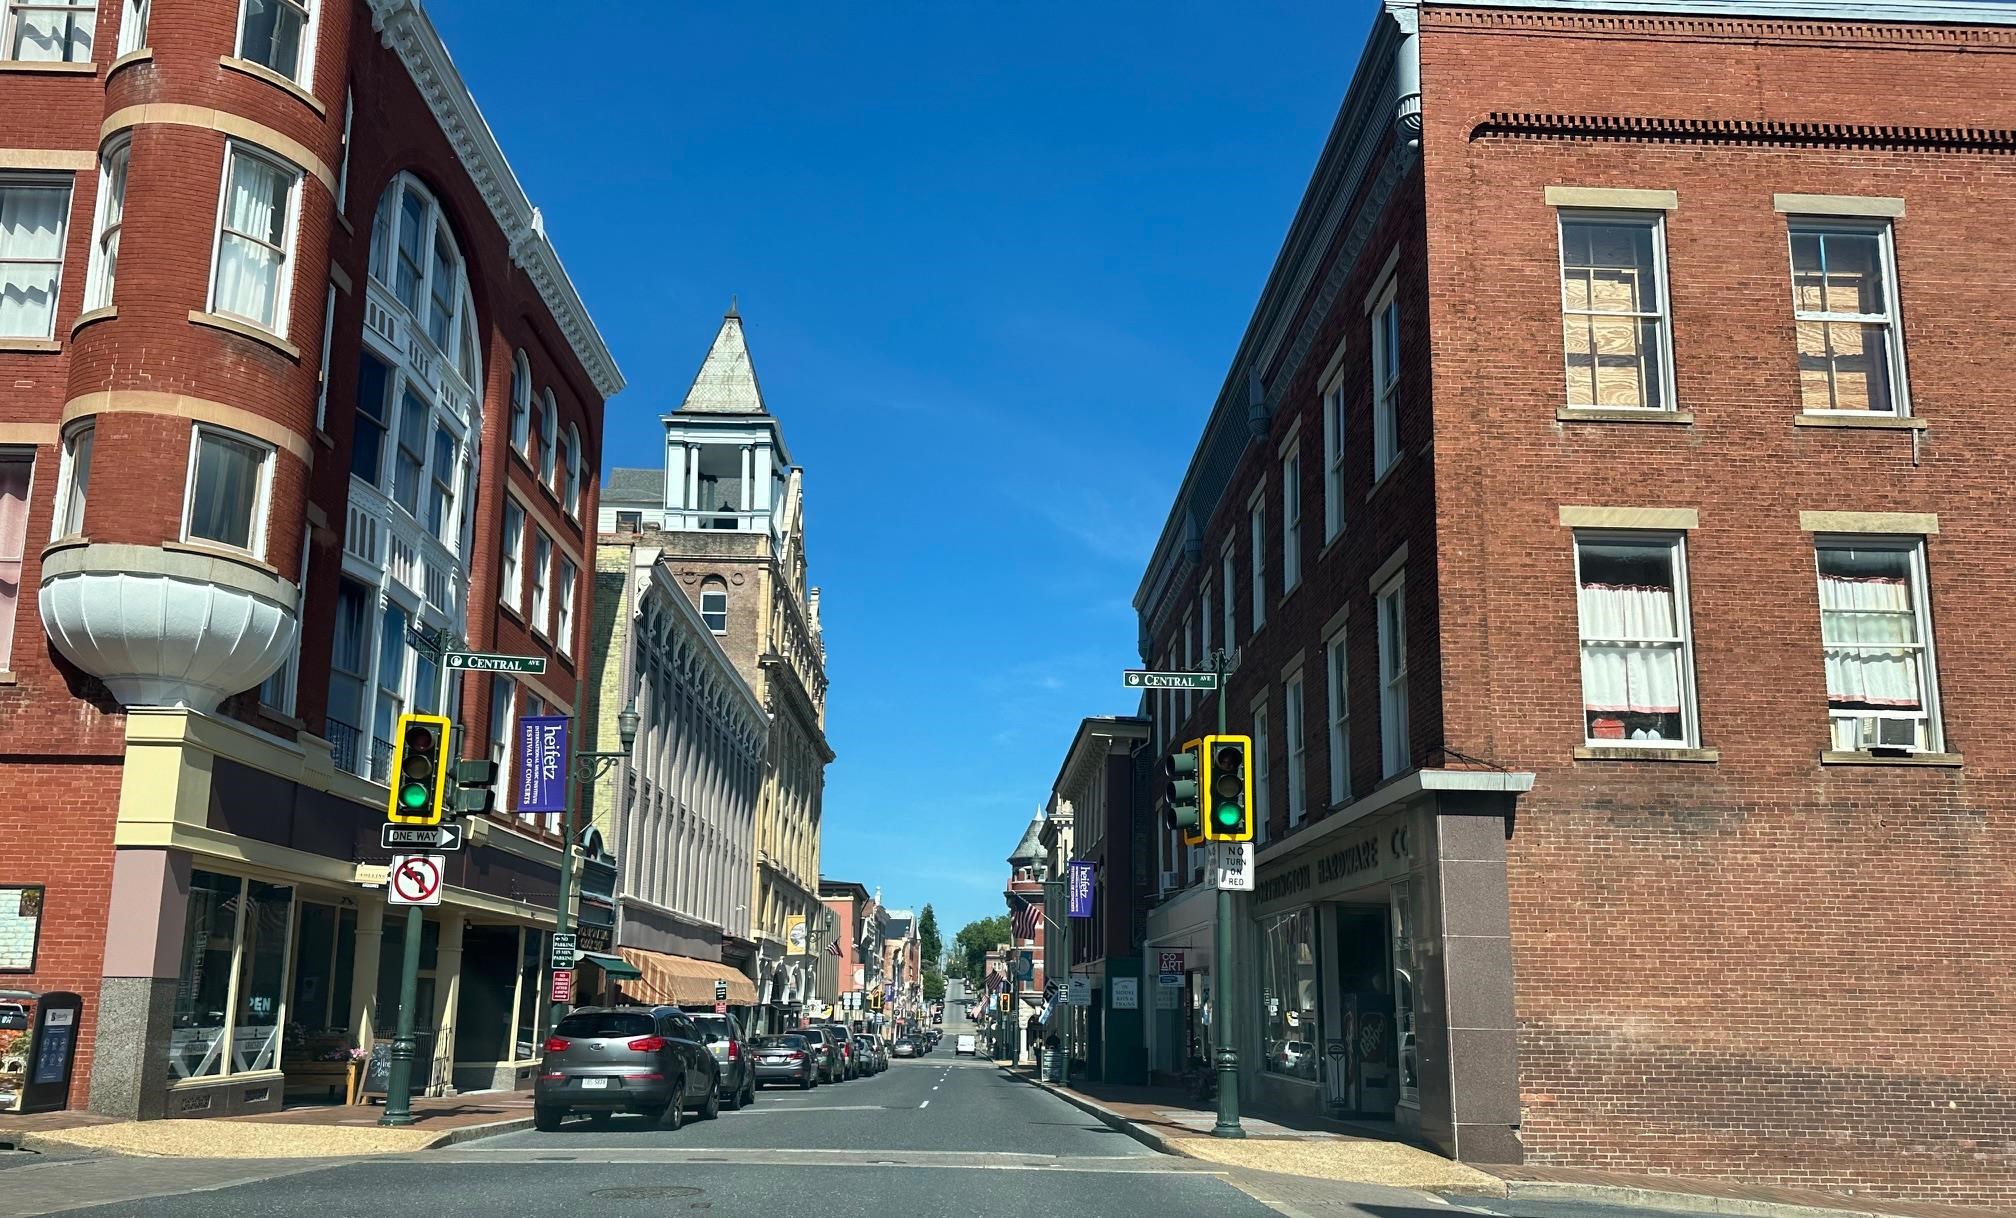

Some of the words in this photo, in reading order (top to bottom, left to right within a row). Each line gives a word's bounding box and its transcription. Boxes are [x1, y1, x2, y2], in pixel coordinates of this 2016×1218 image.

[468, 656, 522, 671] CENTRAL
[1144, 674, 1195, 687] CENTRAL
[544, 725, 562, 780] heifetz
[526, 759, 533, 767] OF
[523, 768, 533, 805] CONCERTS
[392, 832, 413, 840] ONE
[416, 832, 438, 841] WAY
[1228, 846, 1244, 855] NO
[1226, 858, 1247, 866] TURN
[1318, 837, 1378, 884] HARDWARE
[1080, 866, 1091, 899] heifetz
[1228, 877, 1244, 886] RED
[1160, 961, 1183, 971] ART
